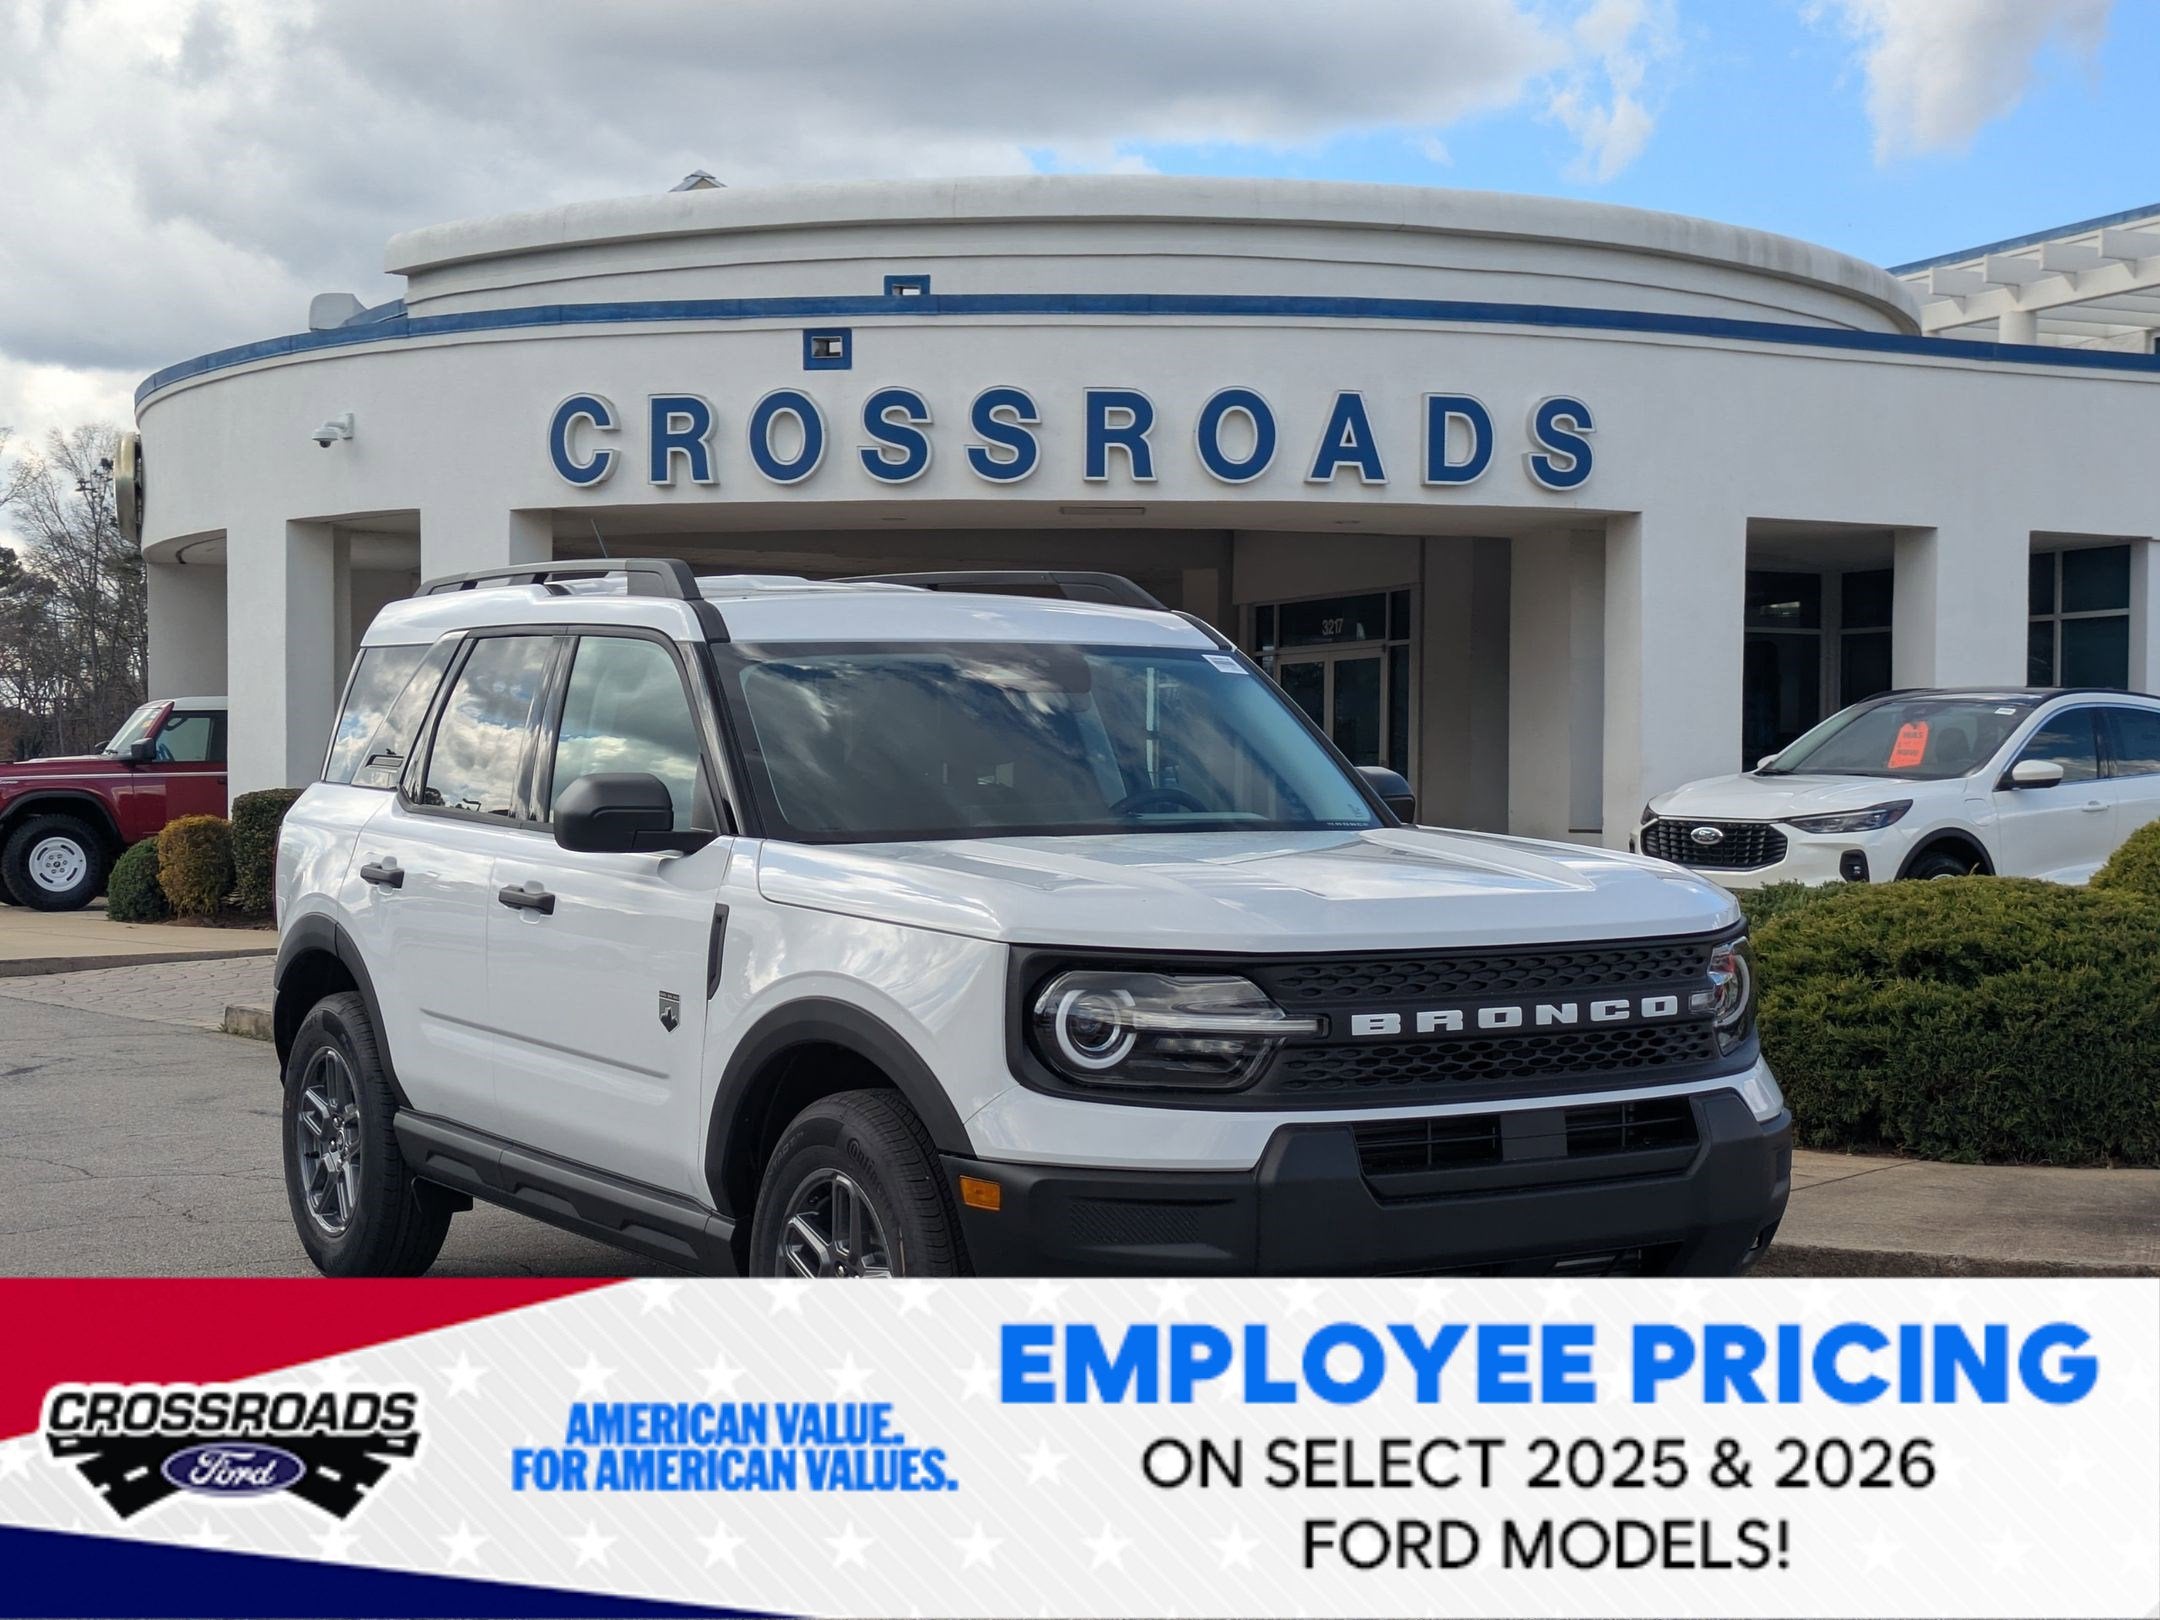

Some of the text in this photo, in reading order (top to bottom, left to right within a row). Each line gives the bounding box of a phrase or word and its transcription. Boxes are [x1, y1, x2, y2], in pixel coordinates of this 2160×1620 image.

[554, 389, 1595, 488] CROSSROADS
[1322, 618, 1344, 636] 3217
[1351, 995, 1678, 1036] BRONCO
